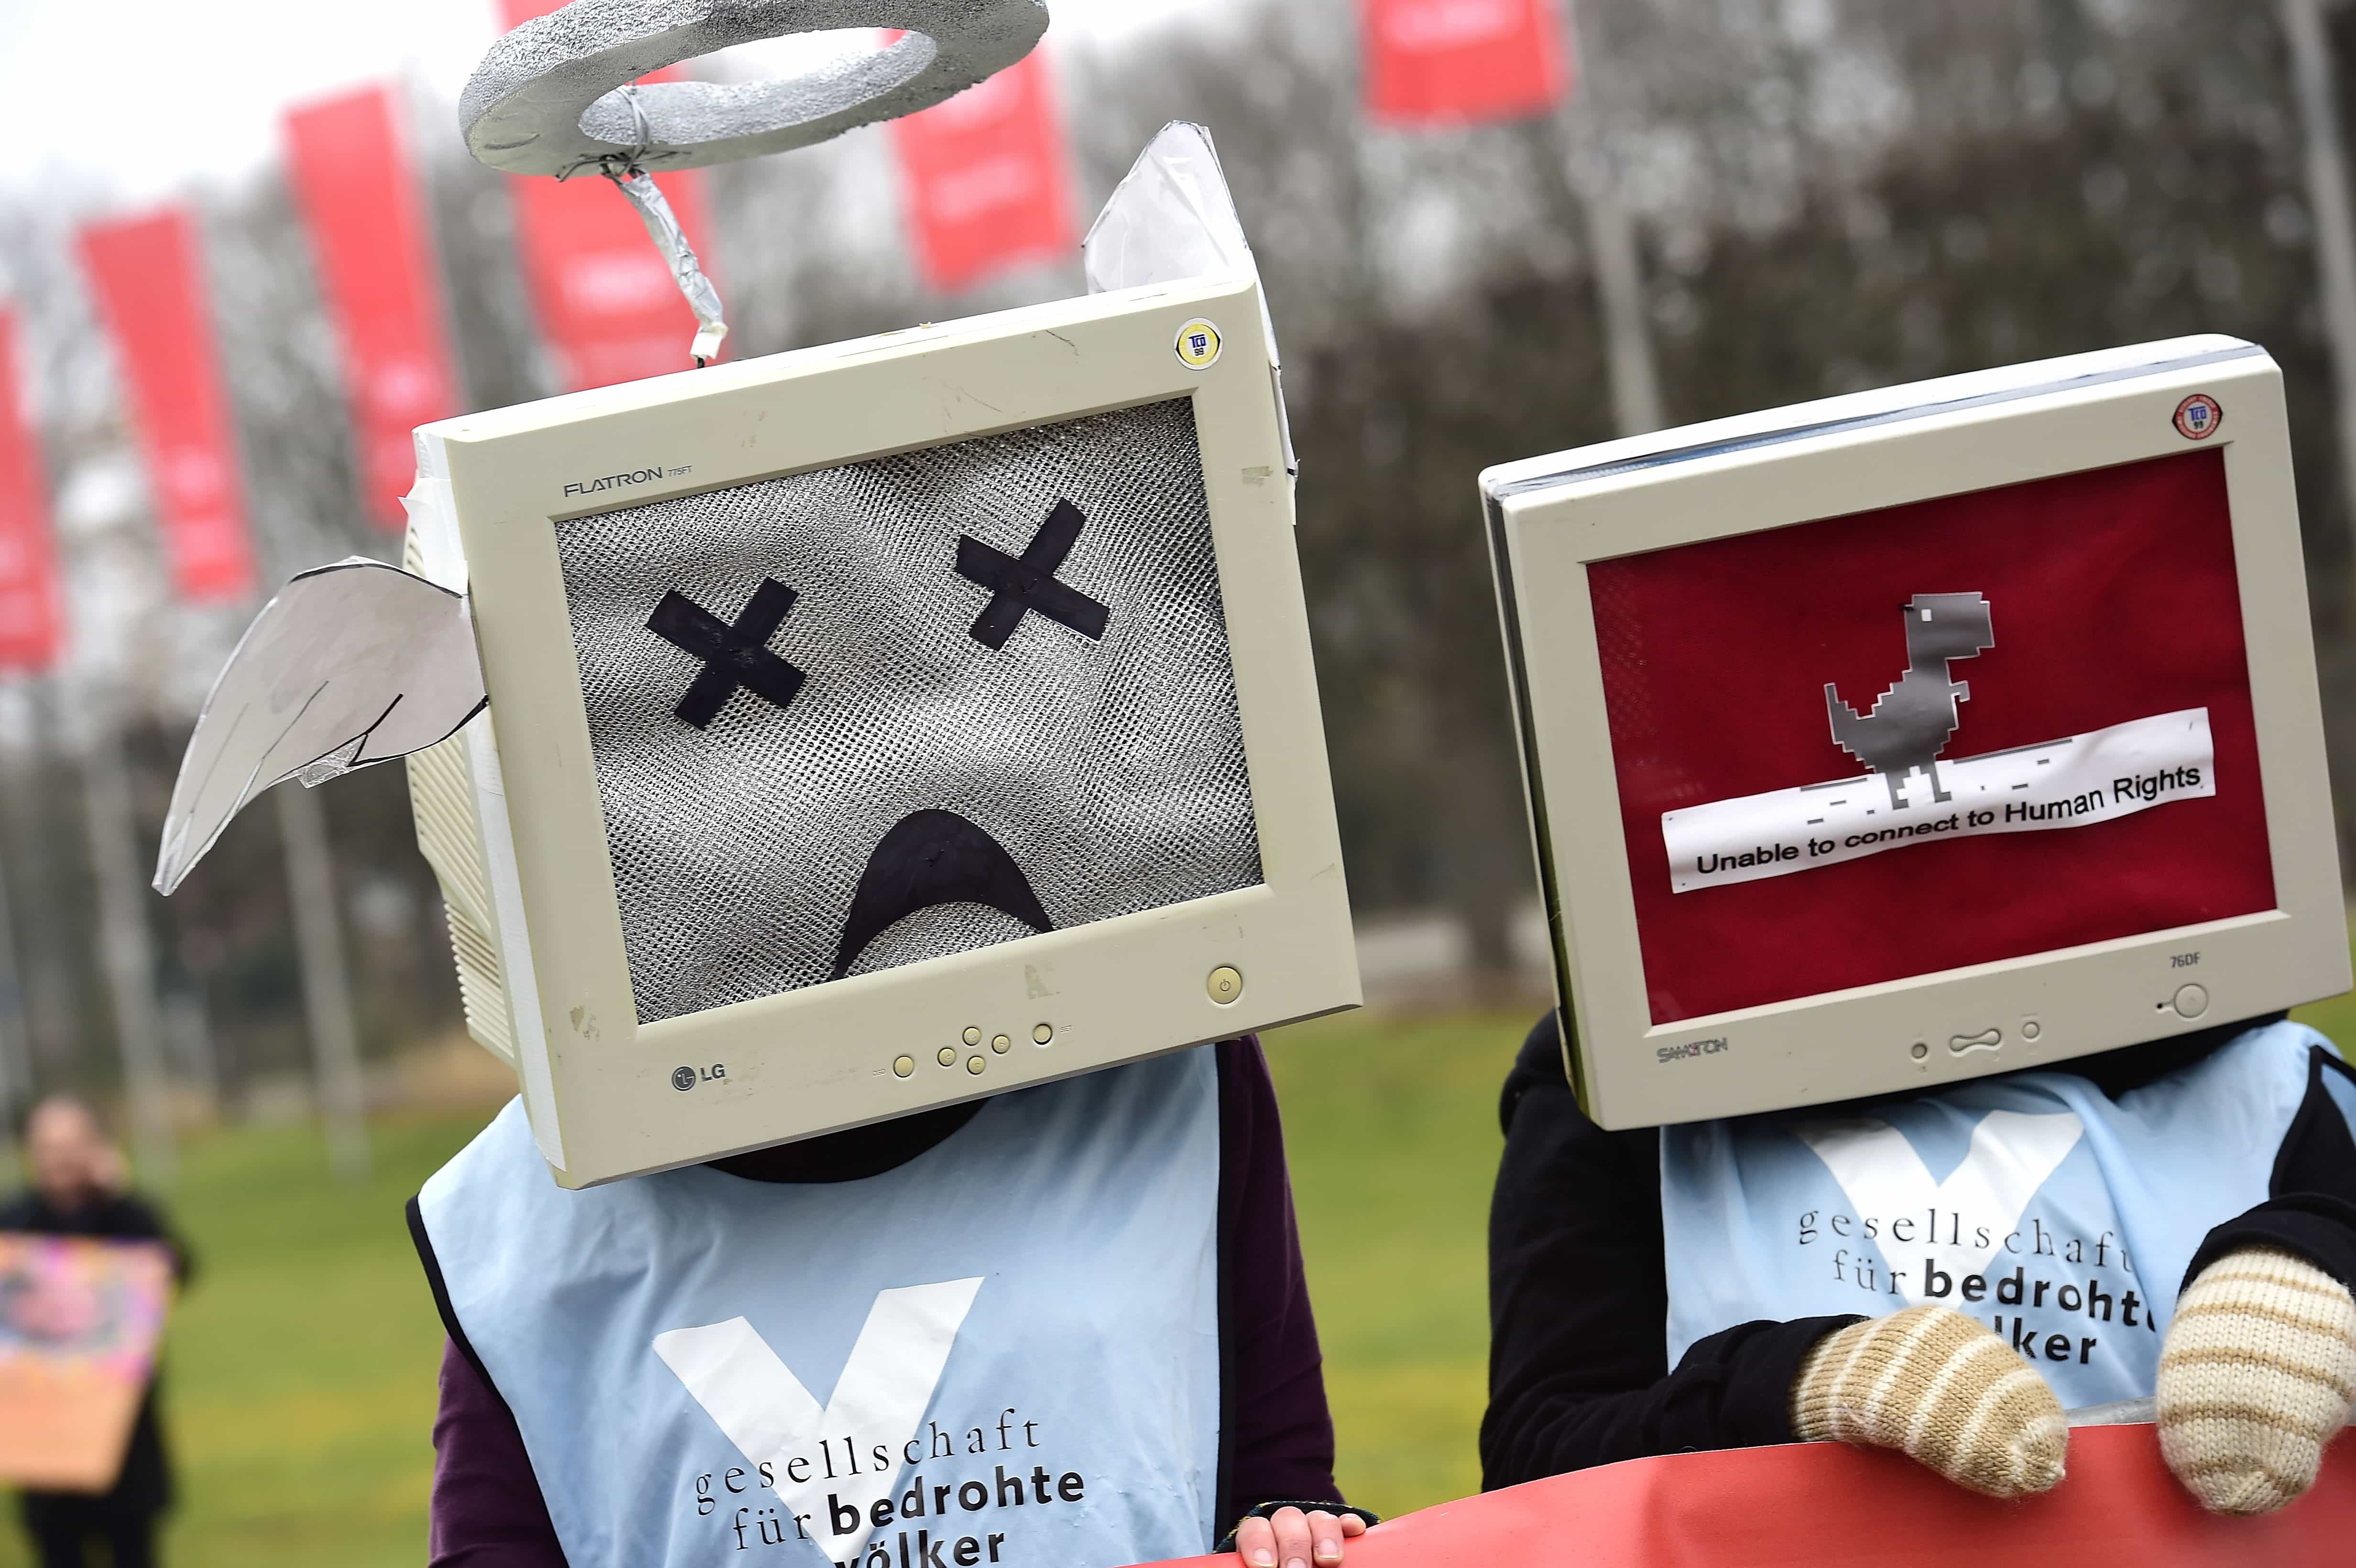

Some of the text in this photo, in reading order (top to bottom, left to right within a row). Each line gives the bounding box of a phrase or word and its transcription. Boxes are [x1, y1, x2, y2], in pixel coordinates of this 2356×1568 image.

[563, 467, 663, 497] FLATRON
[1697, 766, 2201, 875] Unable to connect to Human Rights
[700, 1063, 726, 1082] LG
[1834, 1249, 1907, 1296] für
[695, 1407, 1040, 1516] gesellschaft
[732, 1465, 1084, 1550] für bedrohte
